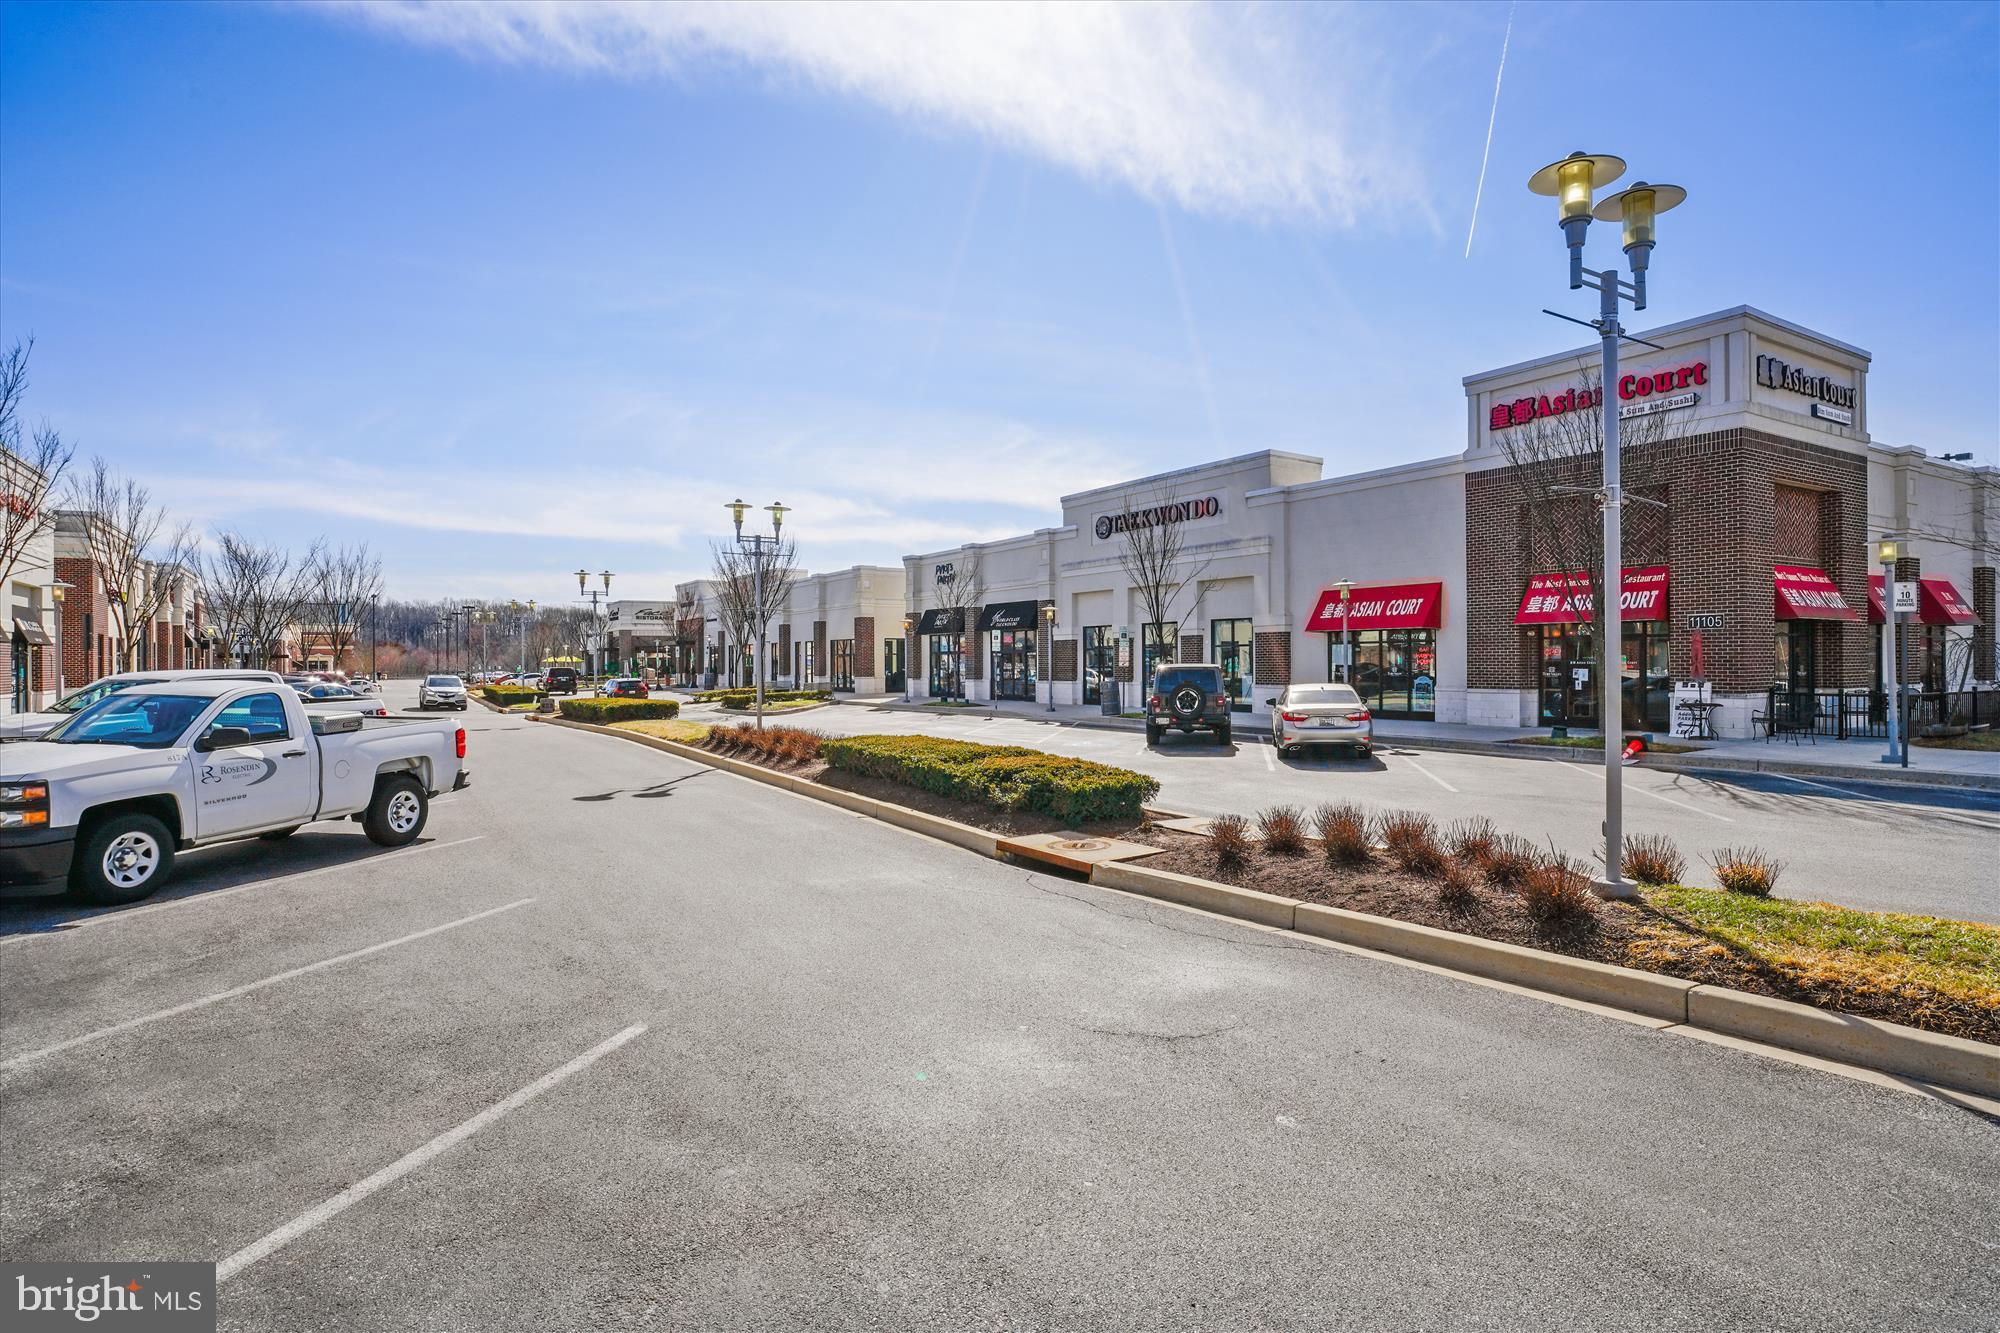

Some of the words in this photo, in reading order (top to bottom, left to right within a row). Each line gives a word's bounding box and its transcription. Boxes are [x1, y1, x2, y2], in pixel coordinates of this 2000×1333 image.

[1618, 362, 1708, 400] Court
[1784, 364, 1820, 398] Asian
[1820, 376, 1857, 409] Court
[1490, 397, 1536, 430] 皇都
[1626, 407, 1645, 415] Sum
[1648, 401, 1666, 411] And
[1669, 395, 1693, 407] Sushi
[1531, 580, 1543, 589] The
[1349, 601, 1385, 617] ASIAN
[1386, 599, 1424, 616] COURT
[1525, 595, 1560, 613] 皇都
[1561, 594, 1595, 612] ASIA
[1620, 590, 1659, 609] OURT
[1689, 616, 1723, 628] 11105
[220, 763, 261, 775] ROSENDIN
